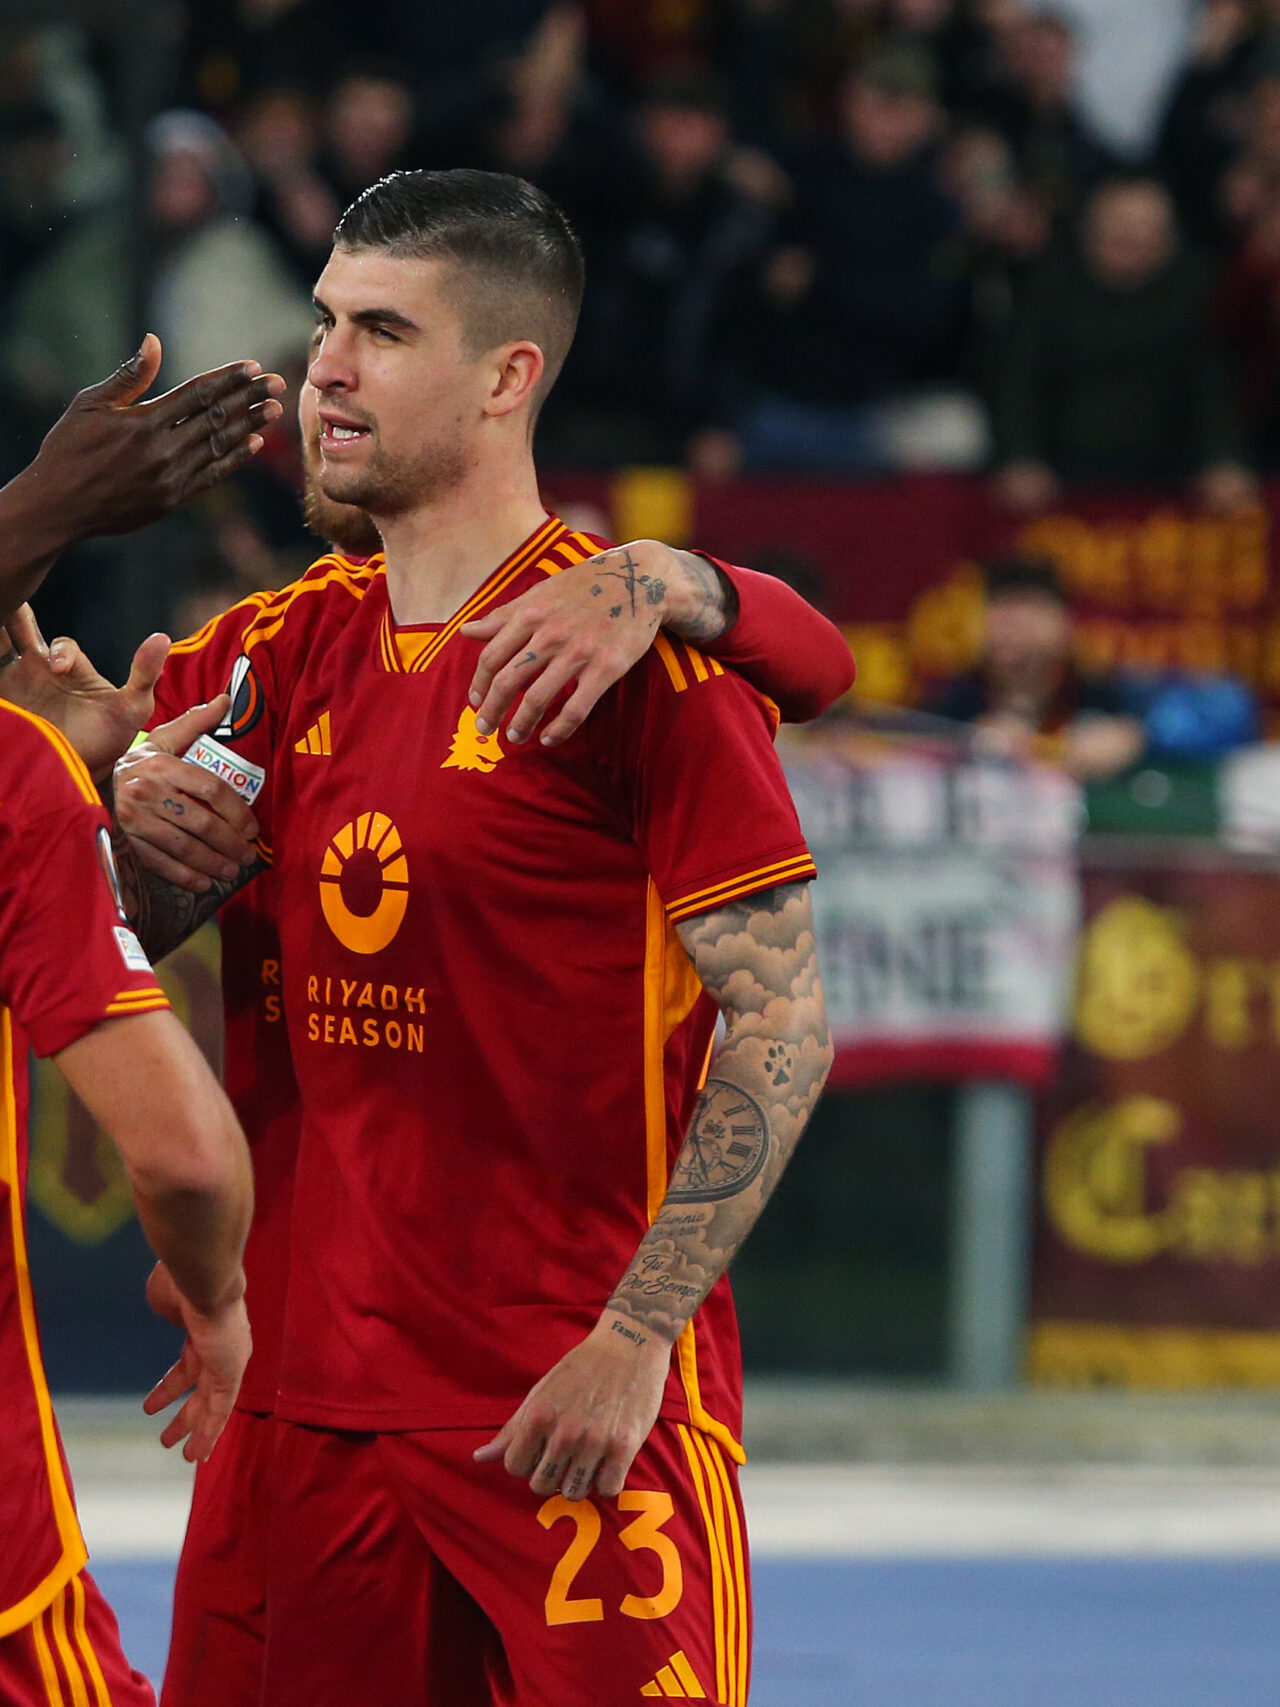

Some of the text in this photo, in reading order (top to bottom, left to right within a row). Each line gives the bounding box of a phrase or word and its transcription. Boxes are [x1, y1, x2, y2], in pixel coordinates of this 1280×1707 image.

[307, 975, 426, 1014] RIYADH
[307, 1013, 424, 1053] SEASON
[536, 1489, 683, 1626] 23
